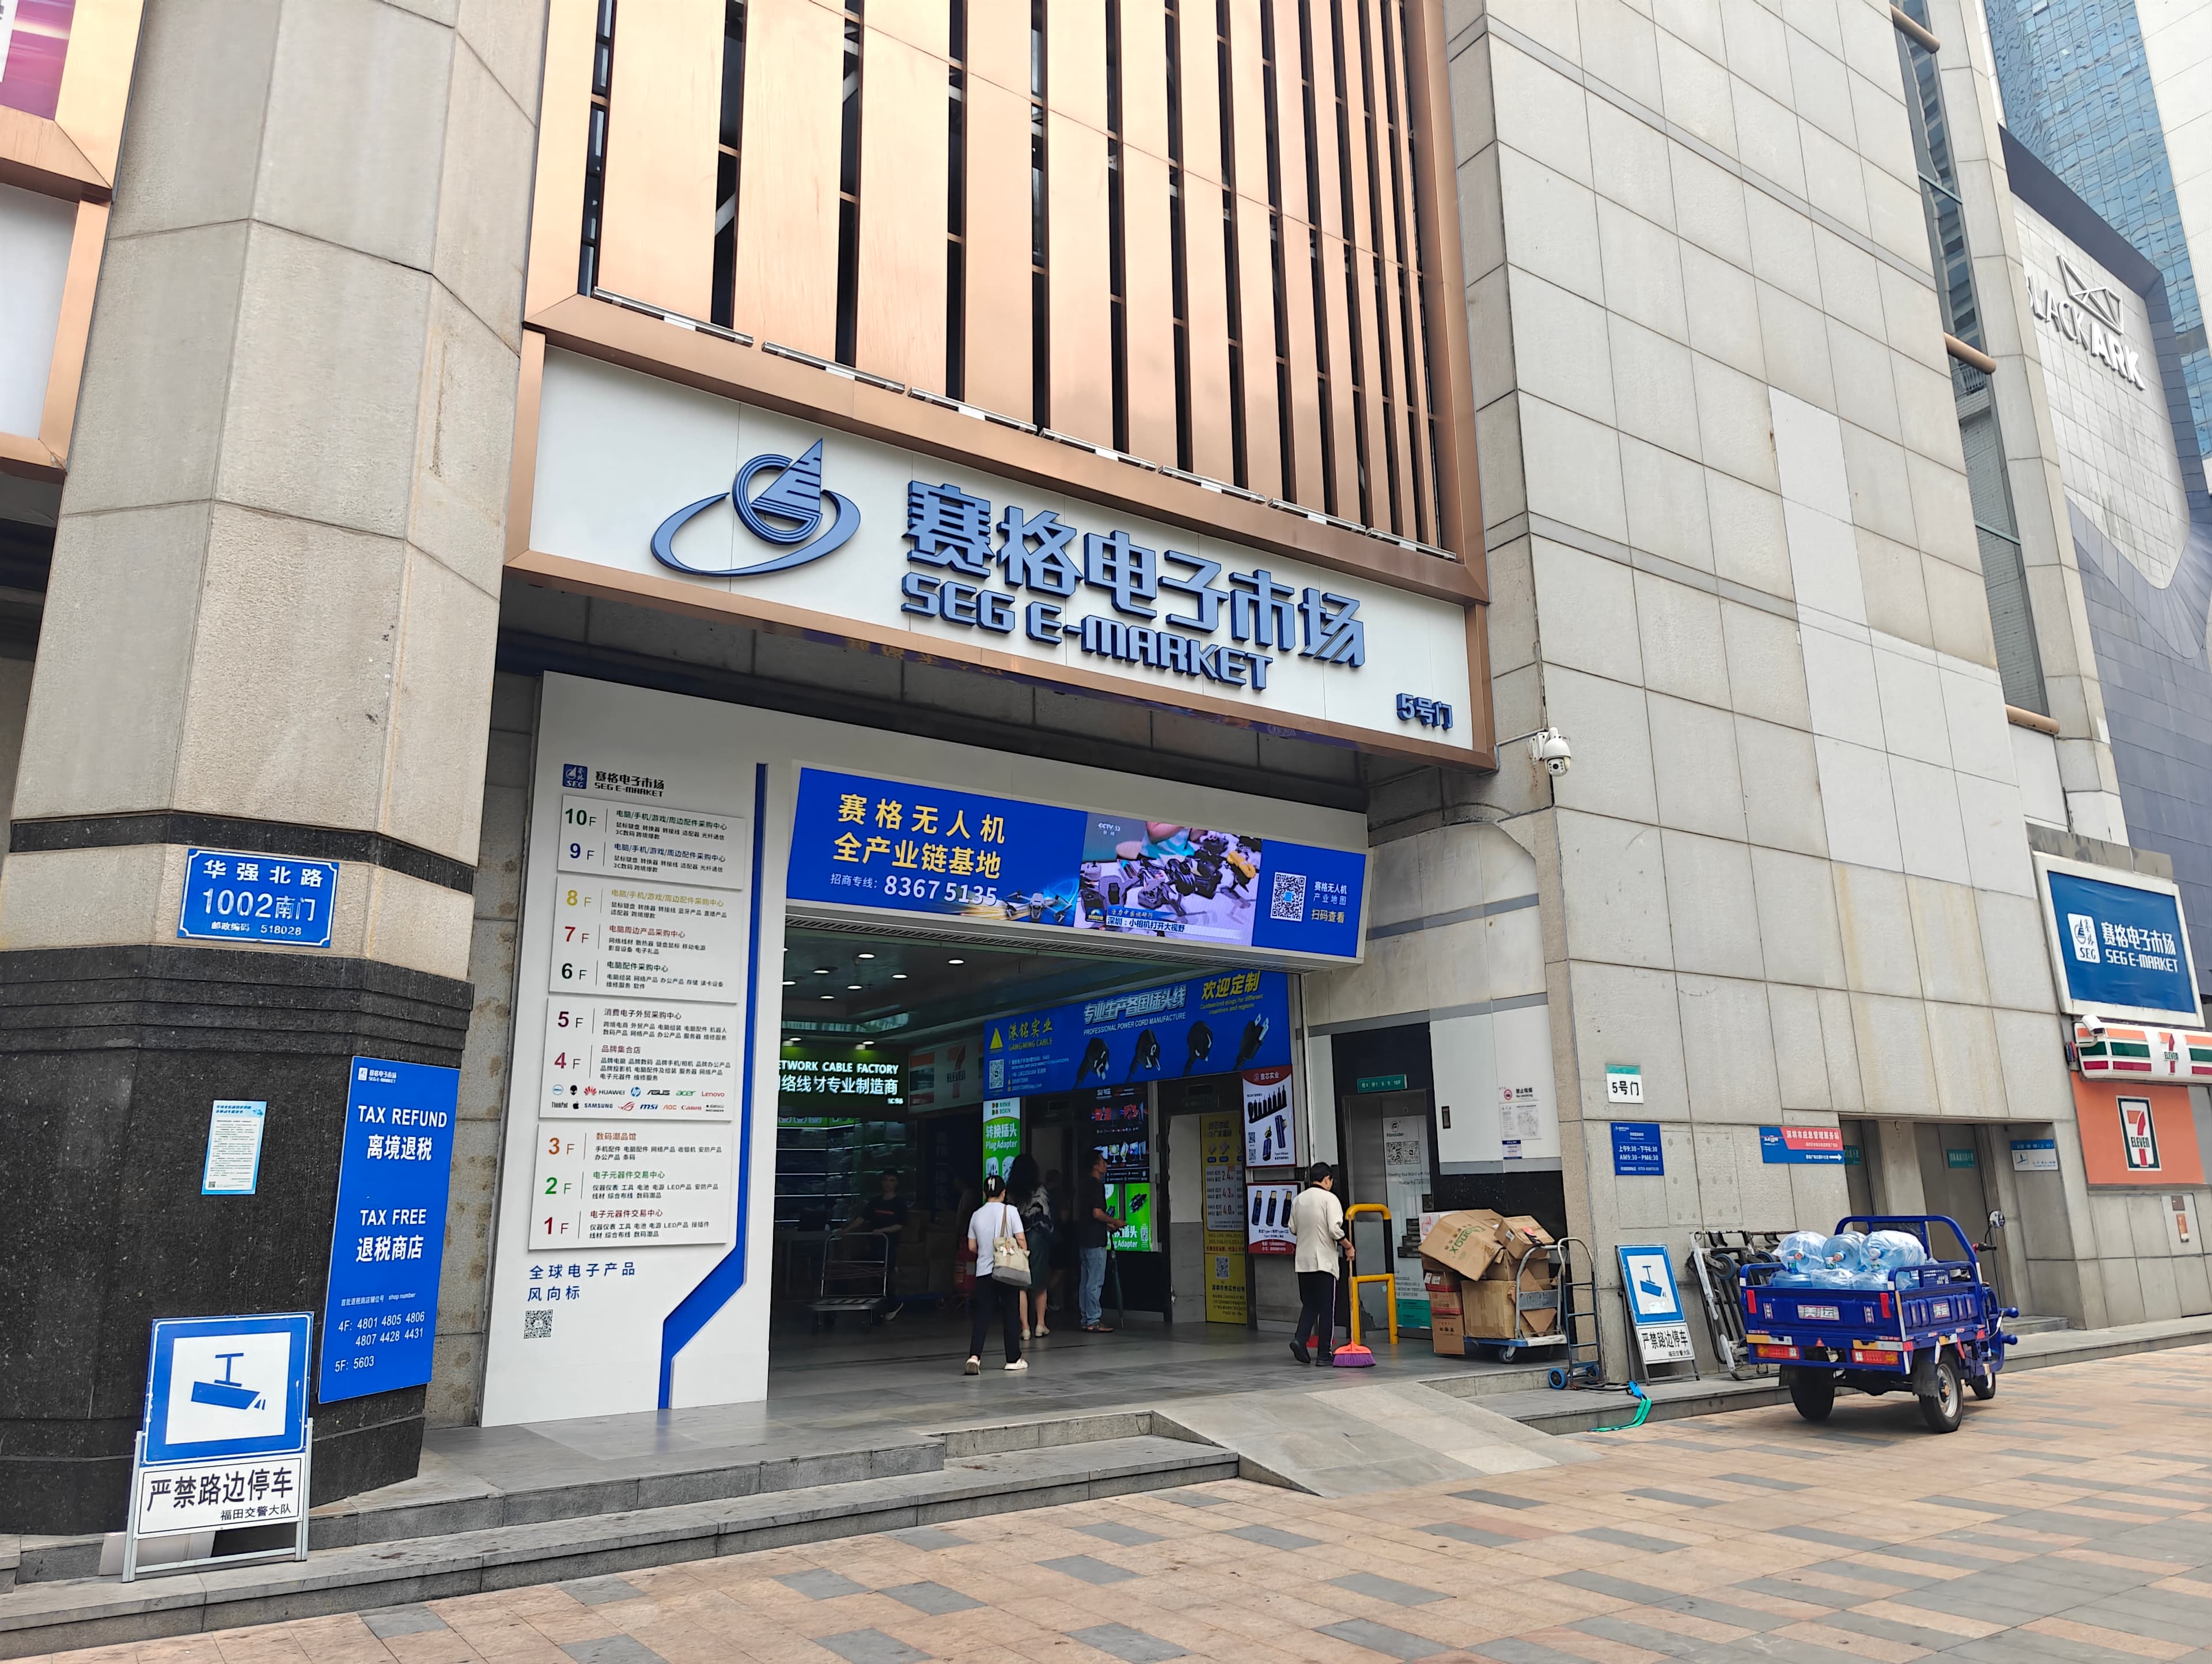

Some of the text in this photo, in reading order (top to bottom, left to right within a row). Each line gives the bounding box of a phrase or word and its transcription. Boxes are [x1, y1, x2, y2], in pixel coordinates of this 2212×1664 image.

[2091, 322, 2146, 391] ARK
[902, 481, 1366, 668] 赛格电子市场
[900, 572, 1015, 633] SEG
[1025, 601, 1273, 690] E-MARKET
[1396, 693, 1453, 730] 5号门
[594, 782, 663, 797] SEG E-MARKET
[596, 771, 664, 790] 赛格电子市场
[838, 793, 1006, 845] 赛格无人机
[833, 831, 1001, 880] 全产业链基地
[203, 859, 323, 888] 华强北路
[884, 875, 941, 900] 8367
[944, 882, 998, 907] 5135
[1314, 881, 1347, 894] 赛格无人机
[203, 887, 316, 922] 1002南门
[1313, 893, 1346, 905] 产业地图
[1312, 908, 1344, 923] 扫码查看
[211, 921, 302, 936] 邮政编码 518028
[2101, 921, 2176, 955] 赛格电子市场
[2080, 947, 2096, 959] SEG
[2105, 948, 2179, 973] SEG E-MARKET
[1202, 970, 1261, 1000] 欢迎定制
[1084, 984, 1187, 1024] 专业生产各国插头线
[1084, 1012, 1186, 1036] PROFESSIONAL POWER CORD MANUFACTURE
[601, 1045, 641, 1054] 品牌集合店
[1009, 1038, 1053, 1051] GANGMING CABLE
[822, 1062, 853, 1073] CABLE
[857, 1064, 899, 1075] FACTORY
[777, 1075, 899, 1095] 络线材专业制造商
[1612, 1080, 1640, 1096] 5号门
[357, 1105, 448, 1129] TAX REFUND
[986, 1122, 1017, 1139] 转换插头
[1786, 1130, 1839, 1140] 深圳市应急管理服务站
[366, 1133, 433, 1162] 离境退税
[986, 1140, 1017, 1151] Plug Adapter
[593, 1171, 665, 1179] 电子元器件交易中心
[360, 1208, 426, 1226] TAX FREE
[590, 1209, 663, 1218] 电子元器件交易中心
[355, 1234, 424, 1264] 退税商店
[1118, 1240, 1138, 1249] Adapter
[529, 1262, 635, 1280] 全球电子产品
[527, 1285, 580, 1302] 风向标
[1803, 1307, 1834, 1318] 美运
[1935, 1305, 1948, 1316] 美运
[338, 1311, 425, 1332] 4F: 4801 4805 4806
[355, 1327, 423, 1347] 4807 4428 4431
[1642, 1329, 1688, 1350] 严禁路边停车
[335, 1355, 374, 1372] 5F: 5603
[146, 1466, 293, 1512] 严禁路边停车
[220, 1503, 291, 1522] 福田交警大队
